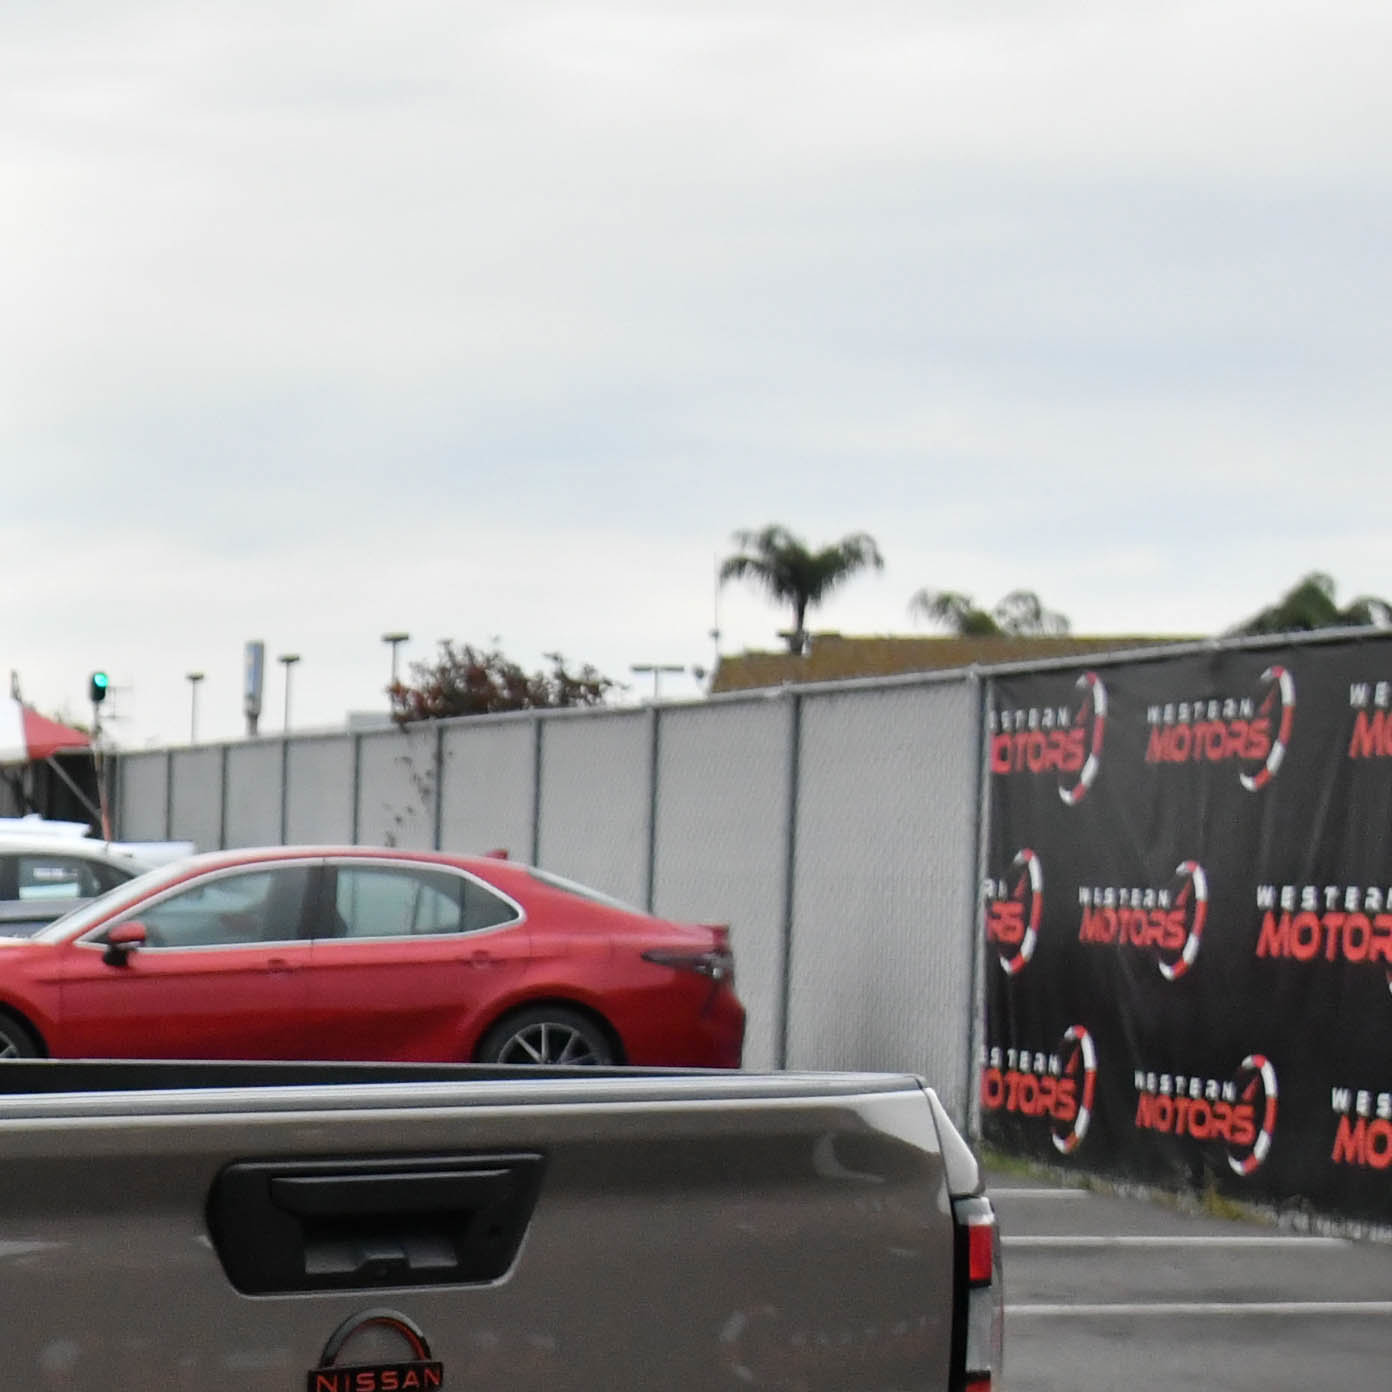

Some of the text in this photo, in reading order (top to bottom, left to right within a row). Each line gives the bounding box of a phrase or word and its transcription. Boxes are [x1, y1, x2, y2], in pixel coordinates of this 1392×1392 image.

[1147, 697, 1254, 724] WESTERN
[1144, 717, 1271, 764] MOTORS
[1079, 886, 1170, 909] WESTERN
[1079, 904, 1186, 949] MOTORS
[1135, 1069, 1234, 1102] WESTERN
[1135, 1092, 1255, 1144] MOTORS
